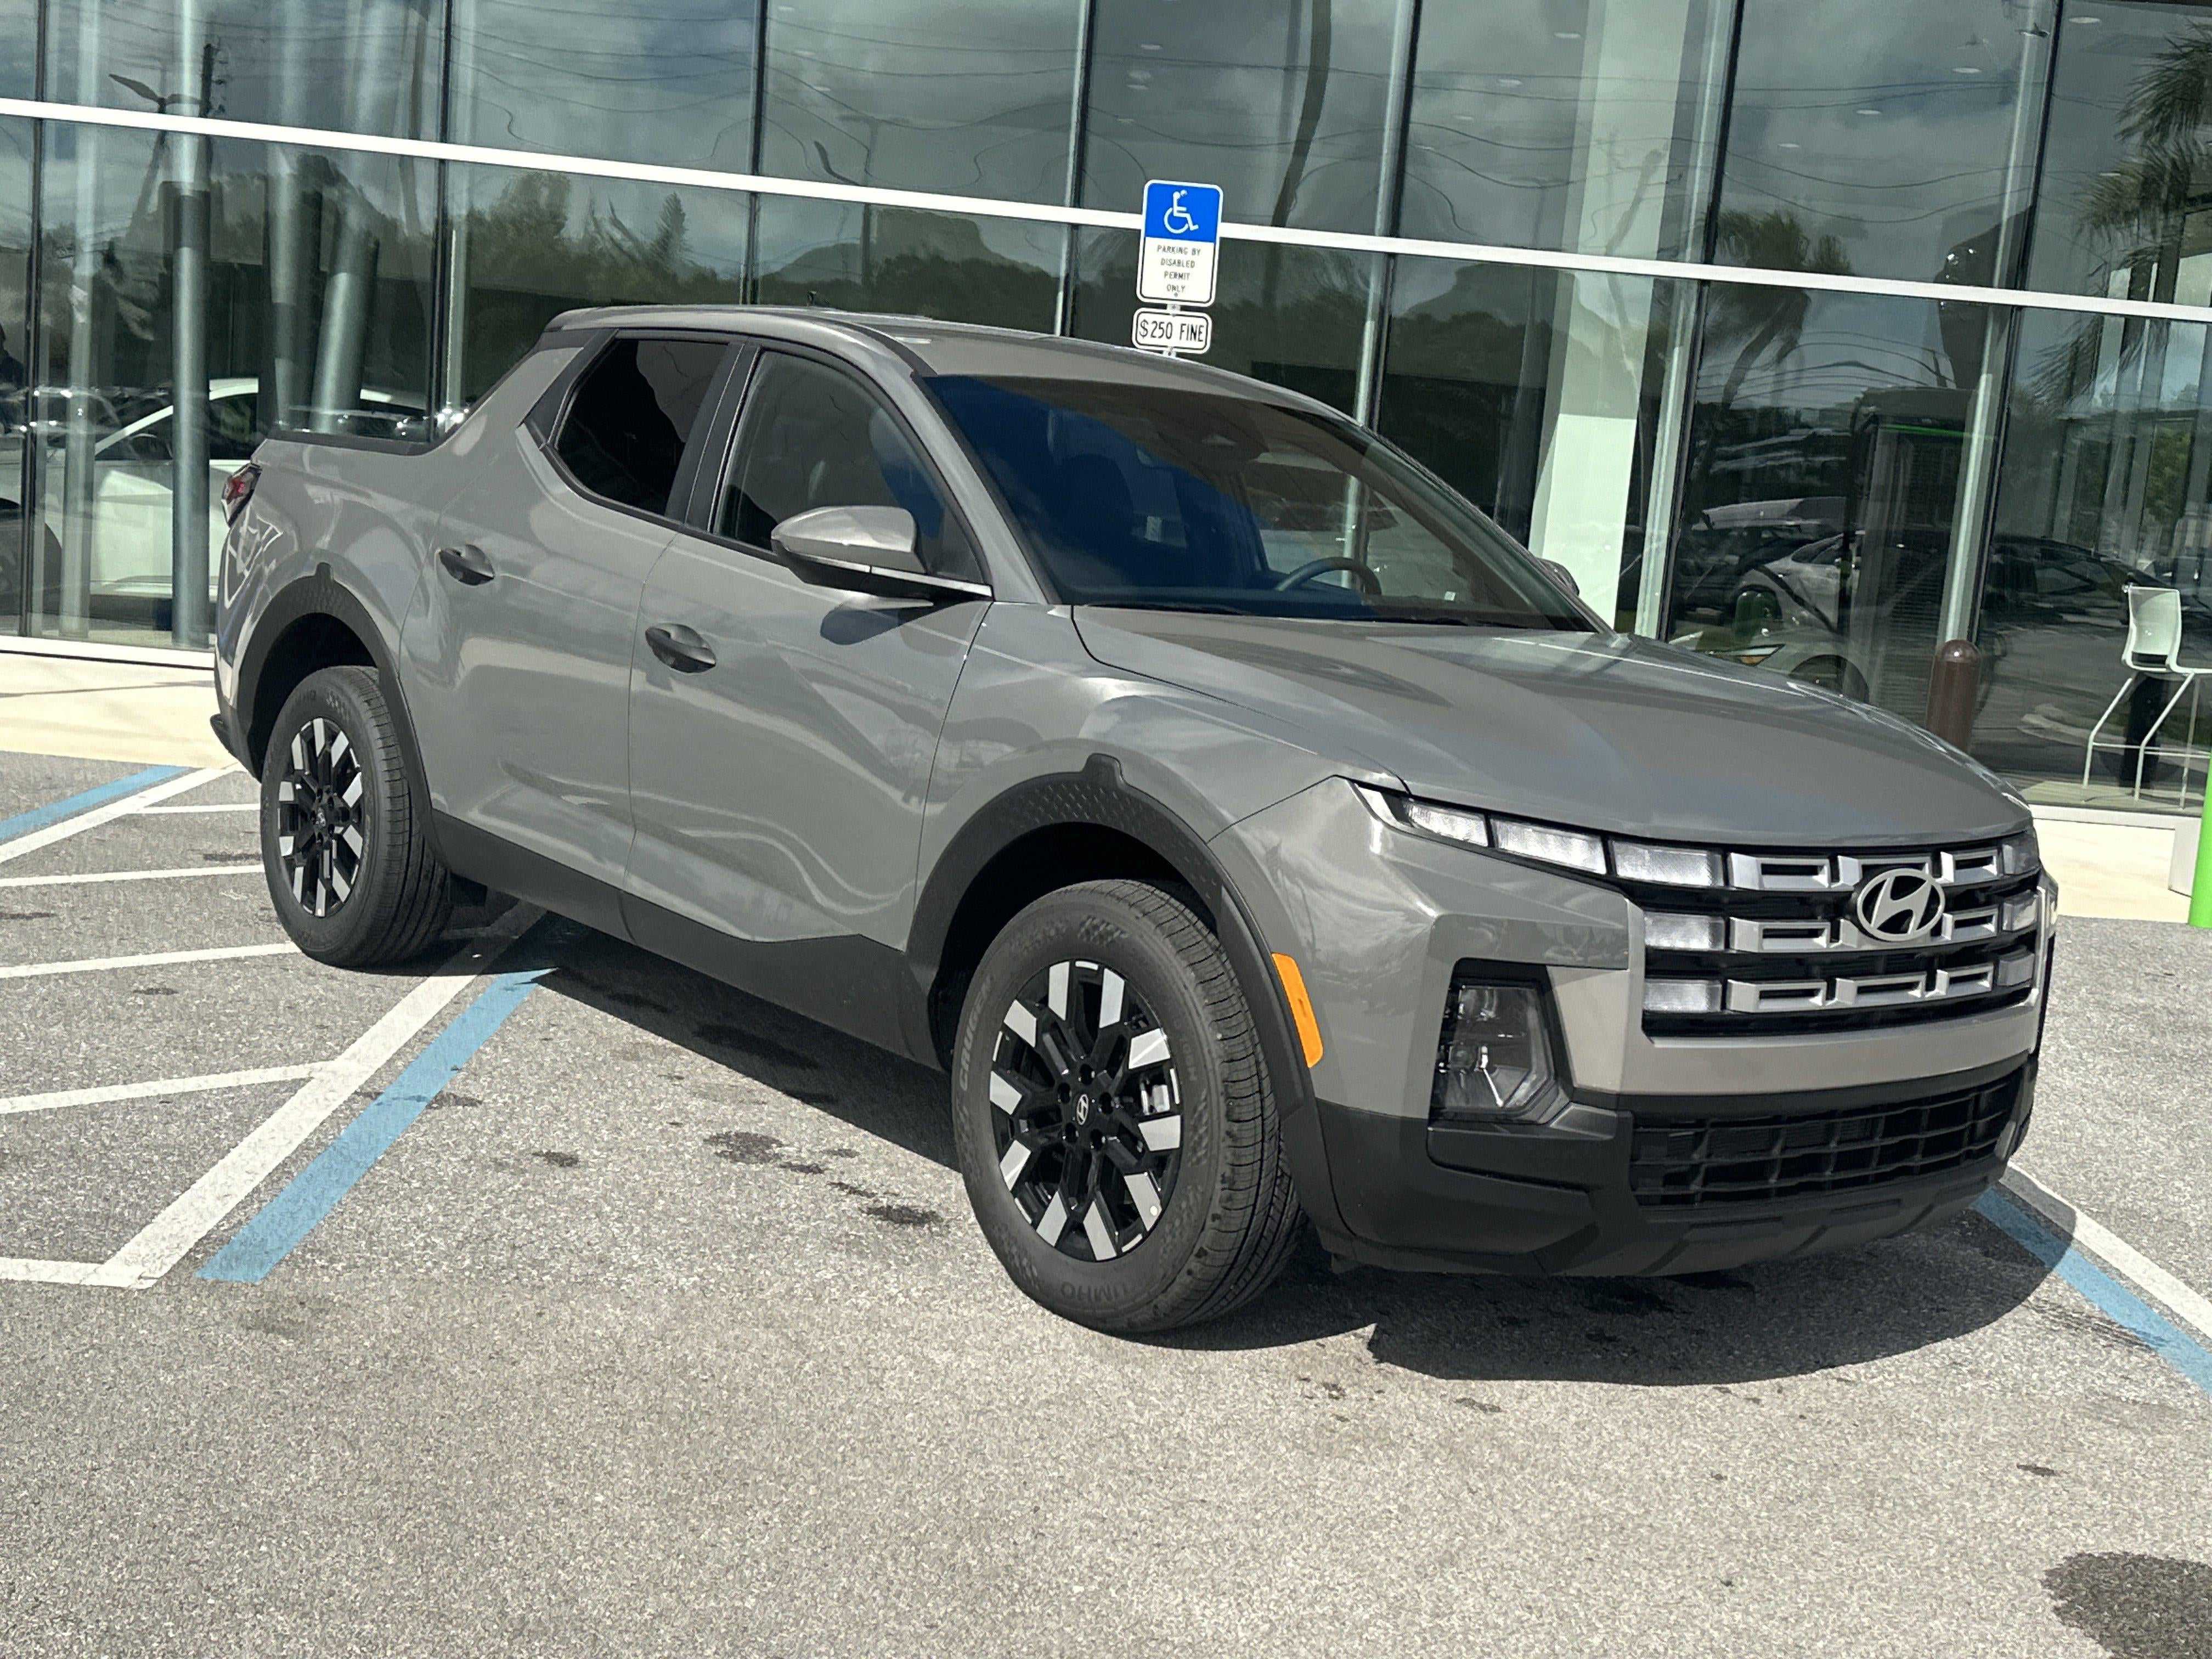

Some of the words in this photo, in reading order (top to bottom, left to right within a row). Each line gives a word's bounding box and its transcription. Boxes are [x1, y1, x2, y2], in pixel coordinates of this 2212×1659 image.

[1156, 245, 1188, 256] PARKING
[1191, 247, 1201, 256] BY
[1160, 258, 1195, 268] DISABLED
[1164, 270, 1190, 280] PERMIT
[1166, 284, 1186, 292] ONLY
[1179, 323, 1205, 342] FINE
[1060, 1279, 1138, 1302] UMHO
